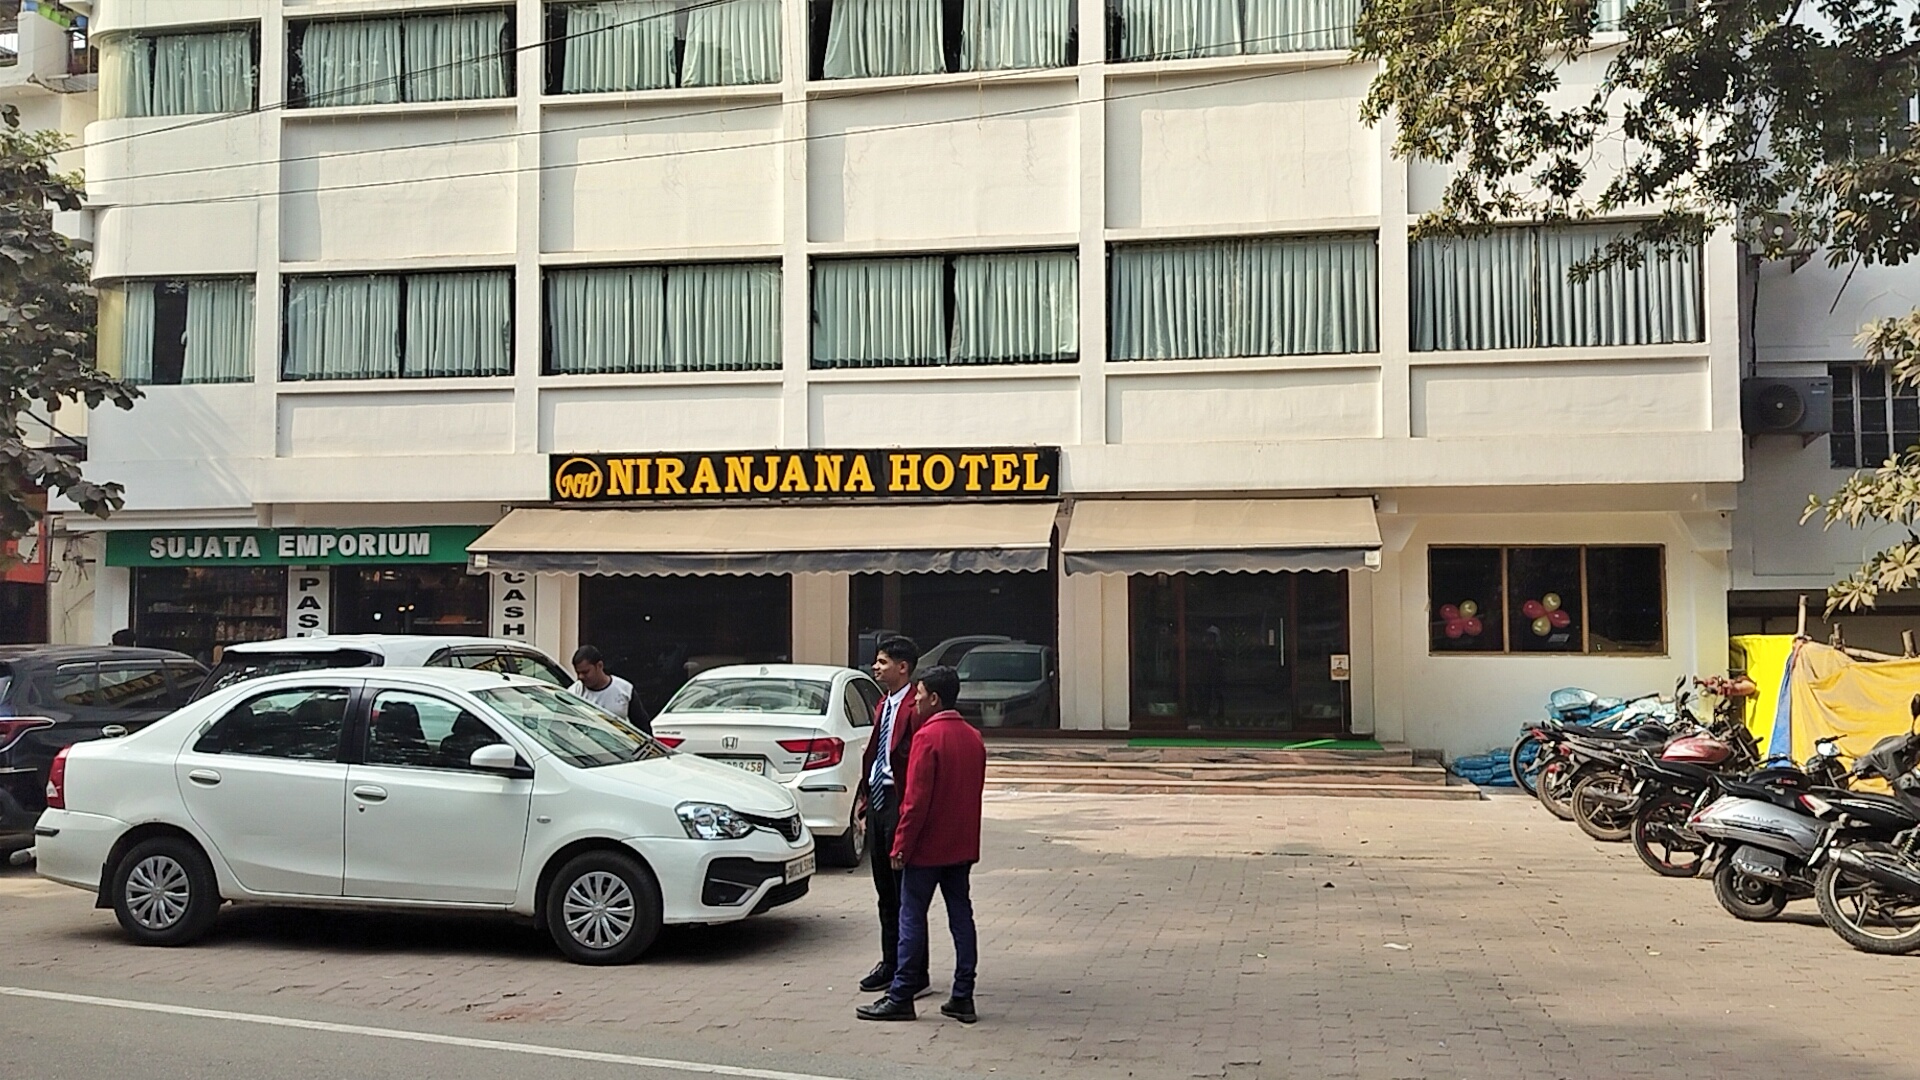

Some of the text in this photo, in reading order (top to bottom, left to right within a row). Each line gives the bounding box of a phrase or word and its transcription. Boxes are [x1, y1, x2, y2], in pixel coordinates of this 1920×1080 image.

[606, 452, 1051, 496] NIRANJANA HOTEL
[149, 532, 431, 559] SUJATA EMPORIUM
[297, 577, 322, 637] PAS
[502, 571, 526, 643] CASH
